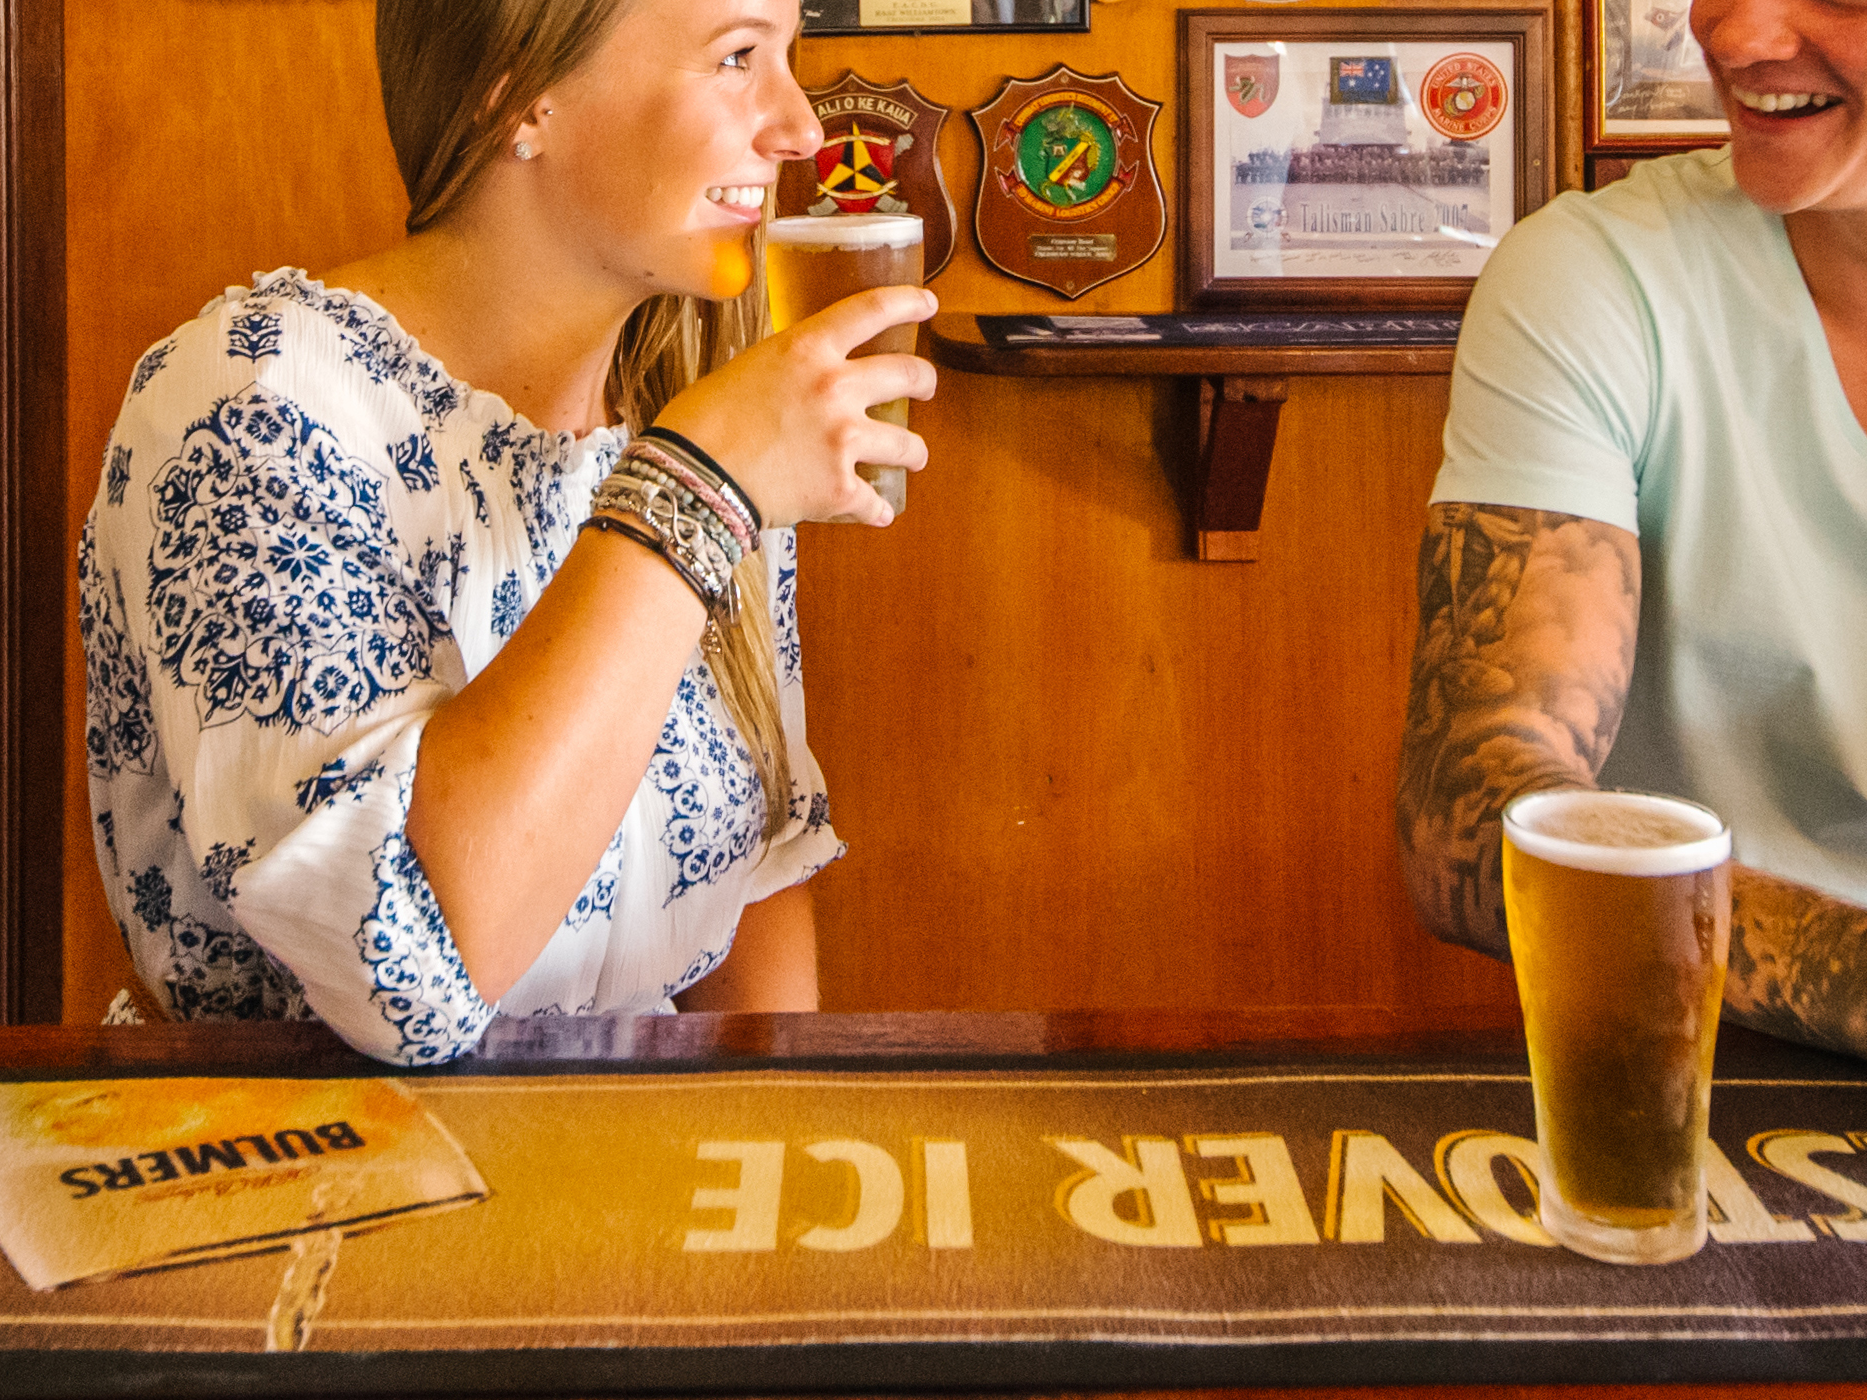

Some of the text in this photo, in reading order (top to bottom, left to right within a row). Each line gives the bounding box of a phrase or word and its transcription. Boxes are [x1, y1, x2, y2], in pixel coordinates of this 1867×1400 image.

[1434, 62, 1495, 88] UNITED STATES
[844, 97, 911, 124] O KE KAUA
[1434, 105, 1496, 131] MARINE CORPS
[1301, 203, 1372, 233] Talisman
[1380, 204, 1425, 233] Sabre
[59, 1121, 366, 1200] BULMERS
[683, 1140, 975, 1252] ICE
[1040, 1132, 1559, 1252] OVER
